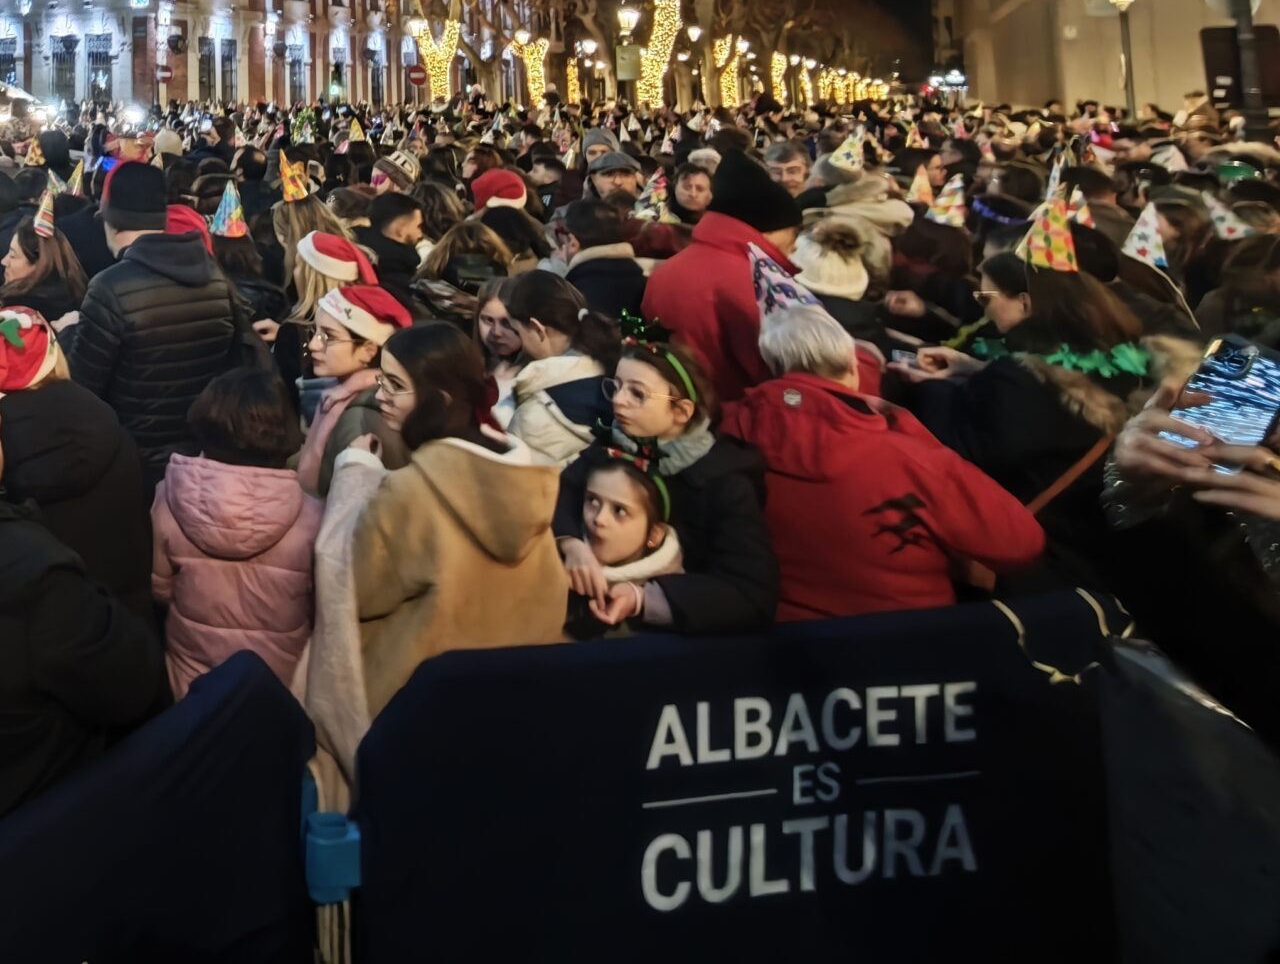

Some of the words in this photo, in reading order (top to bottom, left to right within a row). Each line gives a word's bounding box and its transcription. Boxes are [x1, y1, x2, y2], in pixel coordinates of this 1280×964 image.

[645, 681, 978, 770] ALBACETE
[792, 761, 841, 806] ES
[640, 805, 978, 912] CULTURA
